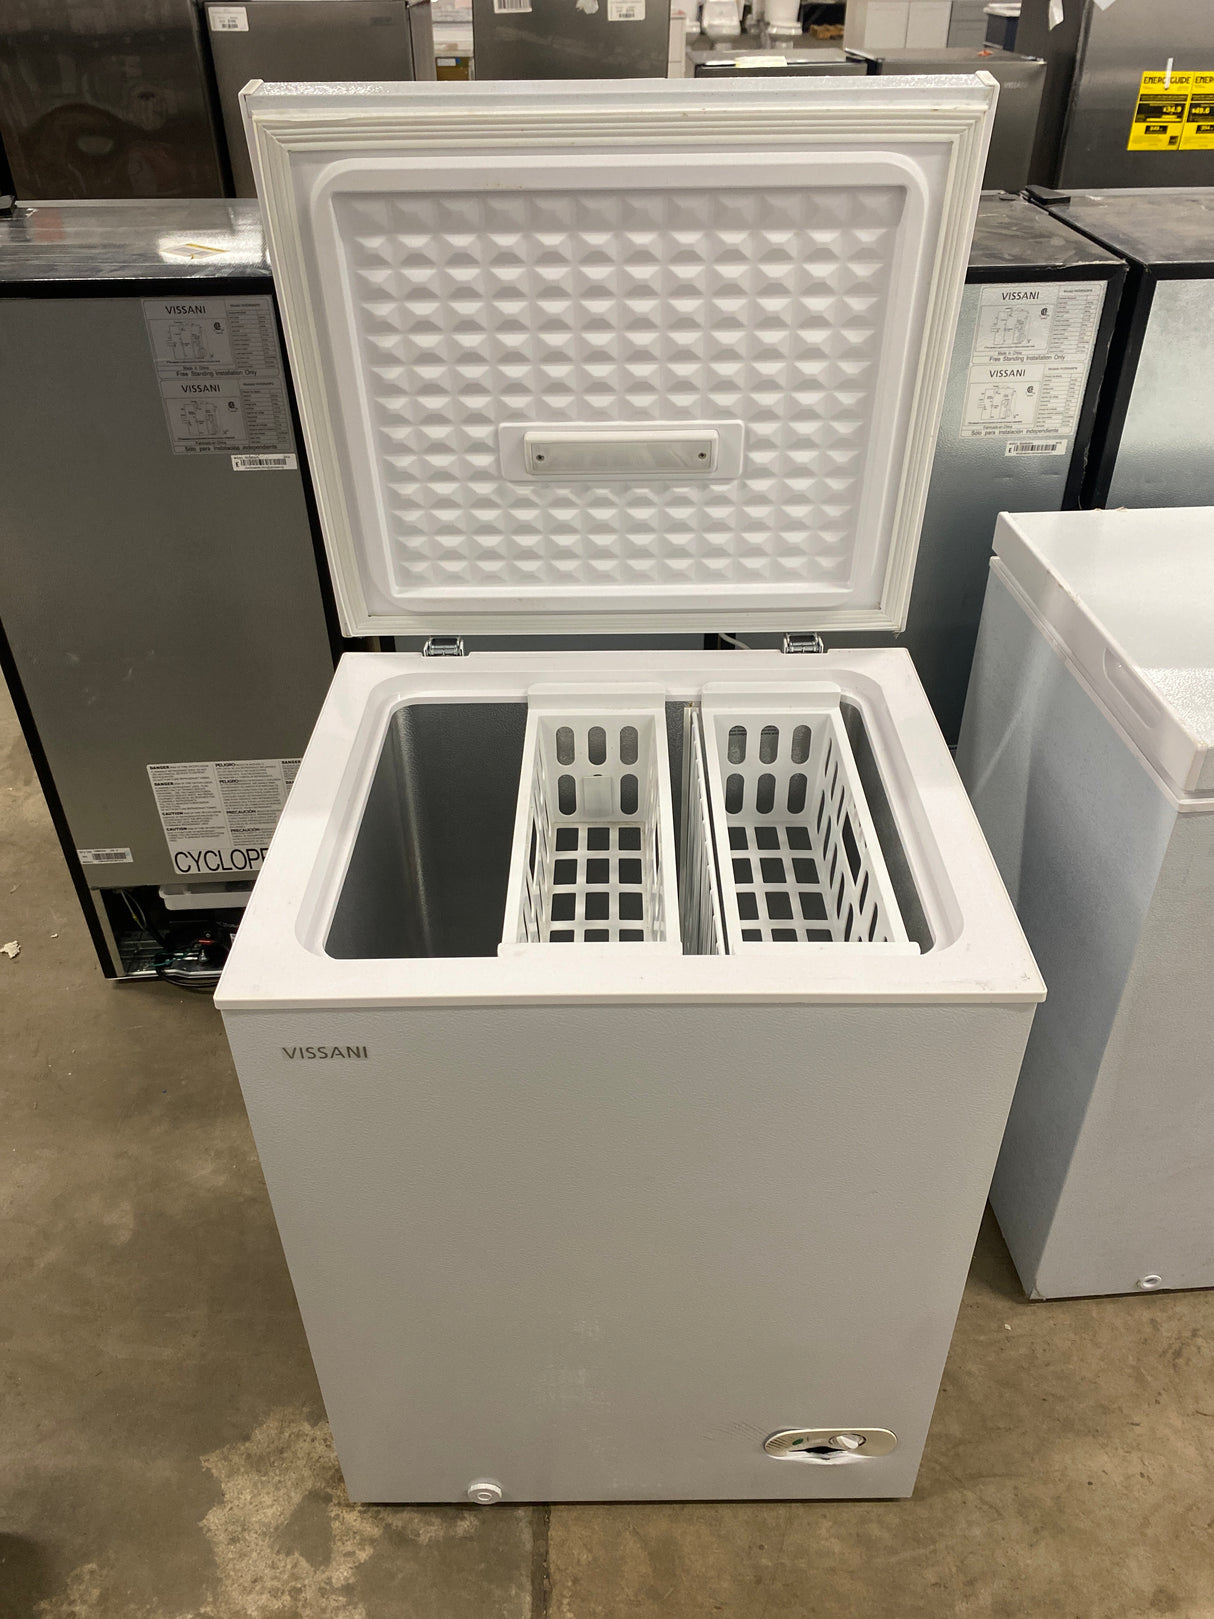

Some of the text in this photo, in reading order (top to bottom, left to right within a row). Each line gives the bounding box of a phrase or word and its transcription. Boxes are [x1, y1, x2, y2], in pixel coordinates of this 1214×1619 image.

[1144, 76, 1191, 84] ENERGGUIDE
[1002, 291, 1040, 300] VISSANI
[165, 306, 206, 315] VISSANI
[989, 369, 1026, 378] VISSANI
[180, 384, 220, 393] VISSANI
[282, 1046, 368, 1059] VISSANI
